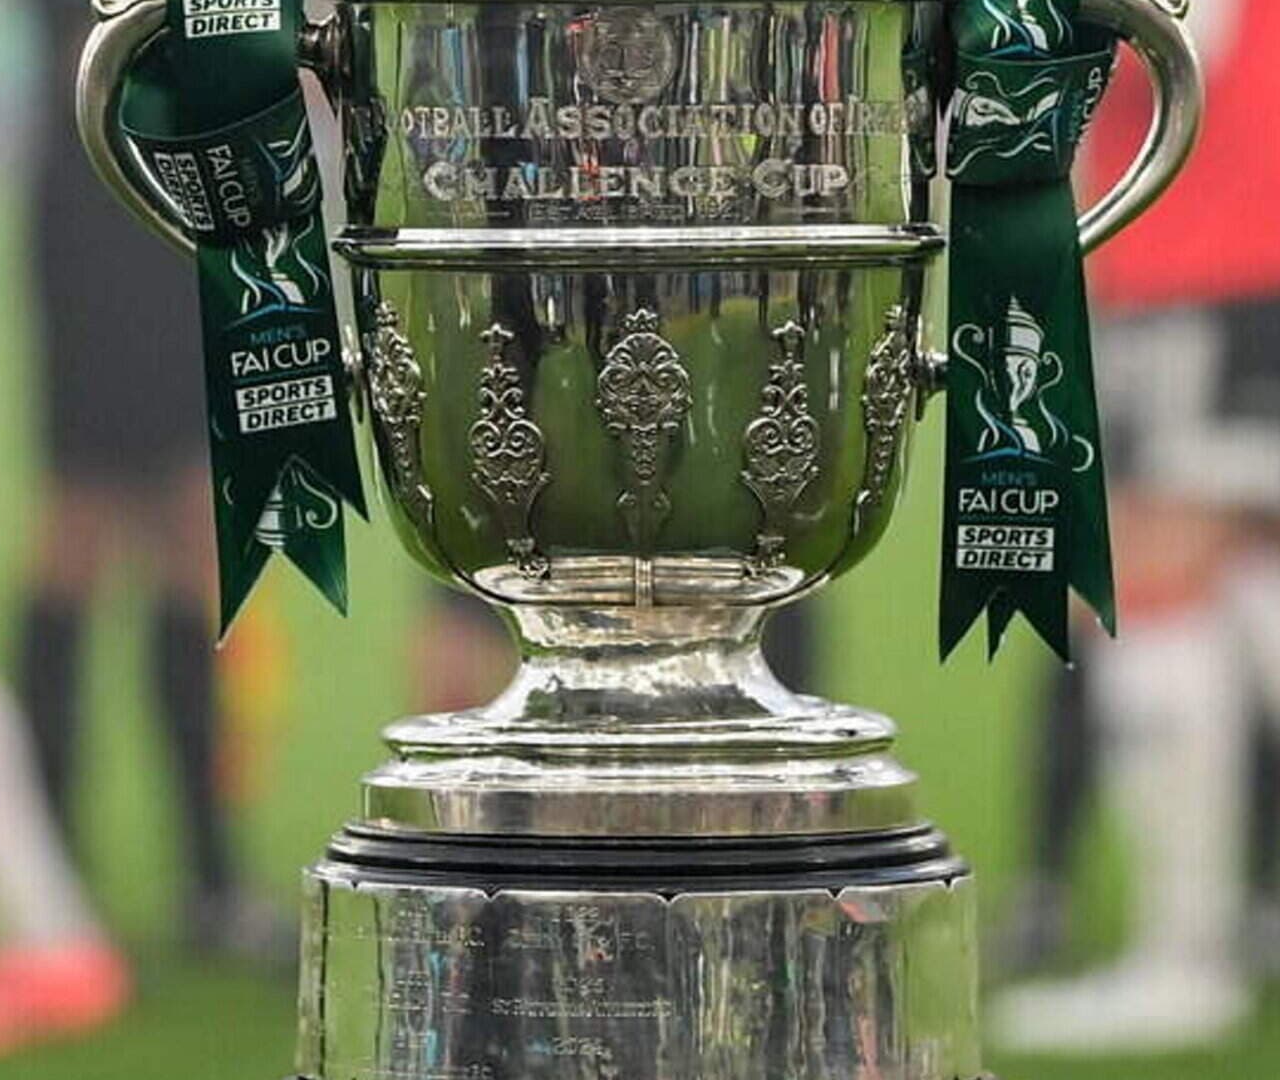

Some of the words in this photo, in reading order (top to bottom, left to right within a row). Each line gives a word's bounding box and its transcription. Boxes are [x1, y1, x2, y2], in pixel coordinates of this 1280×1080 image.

[192, 14, 273, 35] DIRECT
[523, 97, 805, 139] ASSOCIATION
[810, 104, 845, 137] OF
[206, 144, 238, 180] FAI
[176, 156, 211, 226] SPORTS
[423, 161, 739, 201] CHALLENGE
[752, 157, 849, 200] CUP
[218, 180, 251, 228] CUP
[231, 348, 270, 376] FAI
[273, 338, 331, 368] CUP
[244, 378, 327, 407] SPORTS
[247, 401, 329, 428] DIRECT
[959, 488, 997, 513] FAI
[1000, 488, 1060, 515] CUP
[963, 527, 1049, 546] SPORTS
[963, 550, 1047, 569] DIRECT
